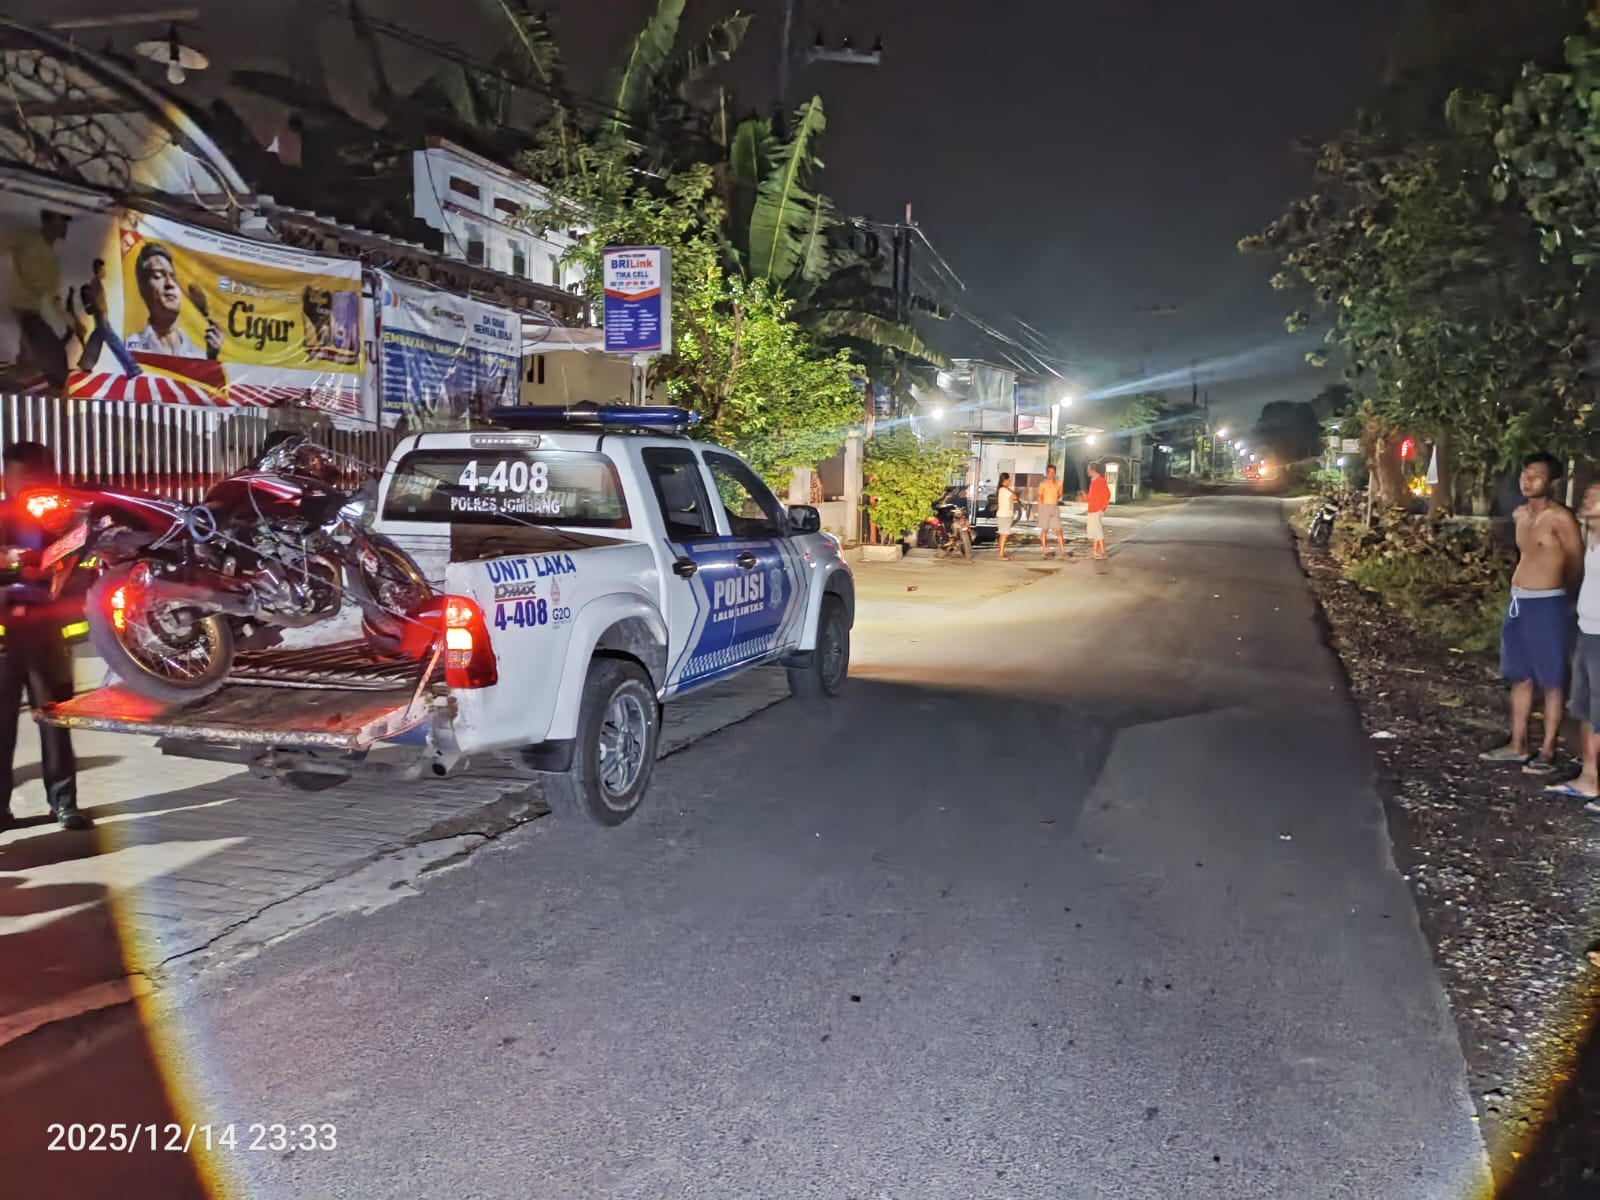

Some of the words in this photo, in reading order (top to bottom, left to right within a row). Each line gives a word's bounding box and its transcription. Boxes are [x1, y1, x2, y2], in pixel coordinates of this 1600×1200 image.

[611, 258, 653, 269] BRILink
[228, 300, 295, 351] Cigar
[459, 460, 549, 493] 4-408
[450, 496, 497, 512] POLRES
[499, 497, 560, 514] JOMBANG
[485, 558, 529, 584] UNIT
[532, 553, 577, 577] LAKA
[713, 572, 765, 610] POLISI
[494, 598, 548, 631] 4-408
[552, 606, 571, 620] G20
[713, 608, 735, 623] LALU
[735, 601, 765, 616] LINTAS
